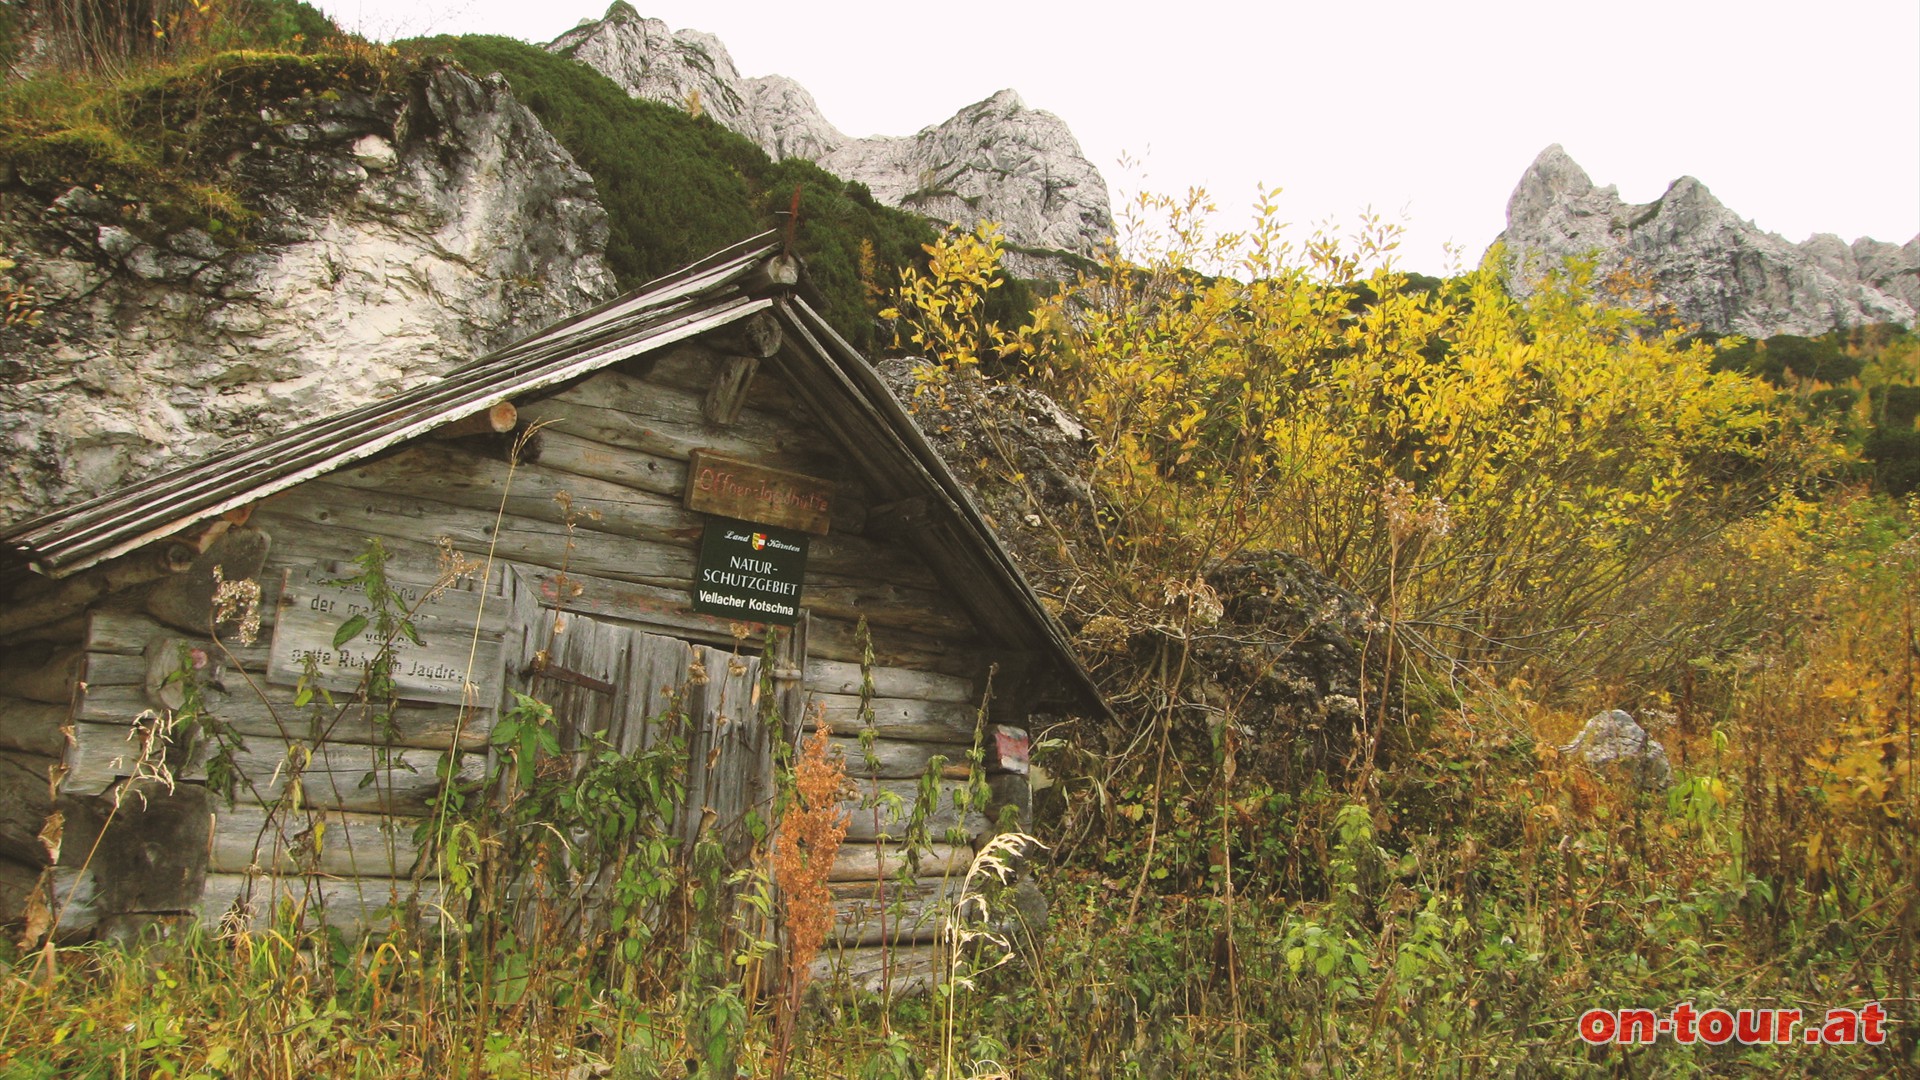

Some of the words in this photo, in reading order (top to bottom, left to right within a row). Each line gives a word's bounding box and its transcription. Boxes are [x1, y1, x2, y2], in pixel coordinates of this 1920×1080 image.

[724, 530, 751, 543] Land
[766, 539, 801, 553] Kärnten
[729, 555, 779, 575] NATUR-
[702, 568, 799, 596] SCHUTZGEBIET
[310, 594, 335, 614] der
[699, 590, 747, 609] Vellacher
[748, 598, 795, 616] Kotschna
